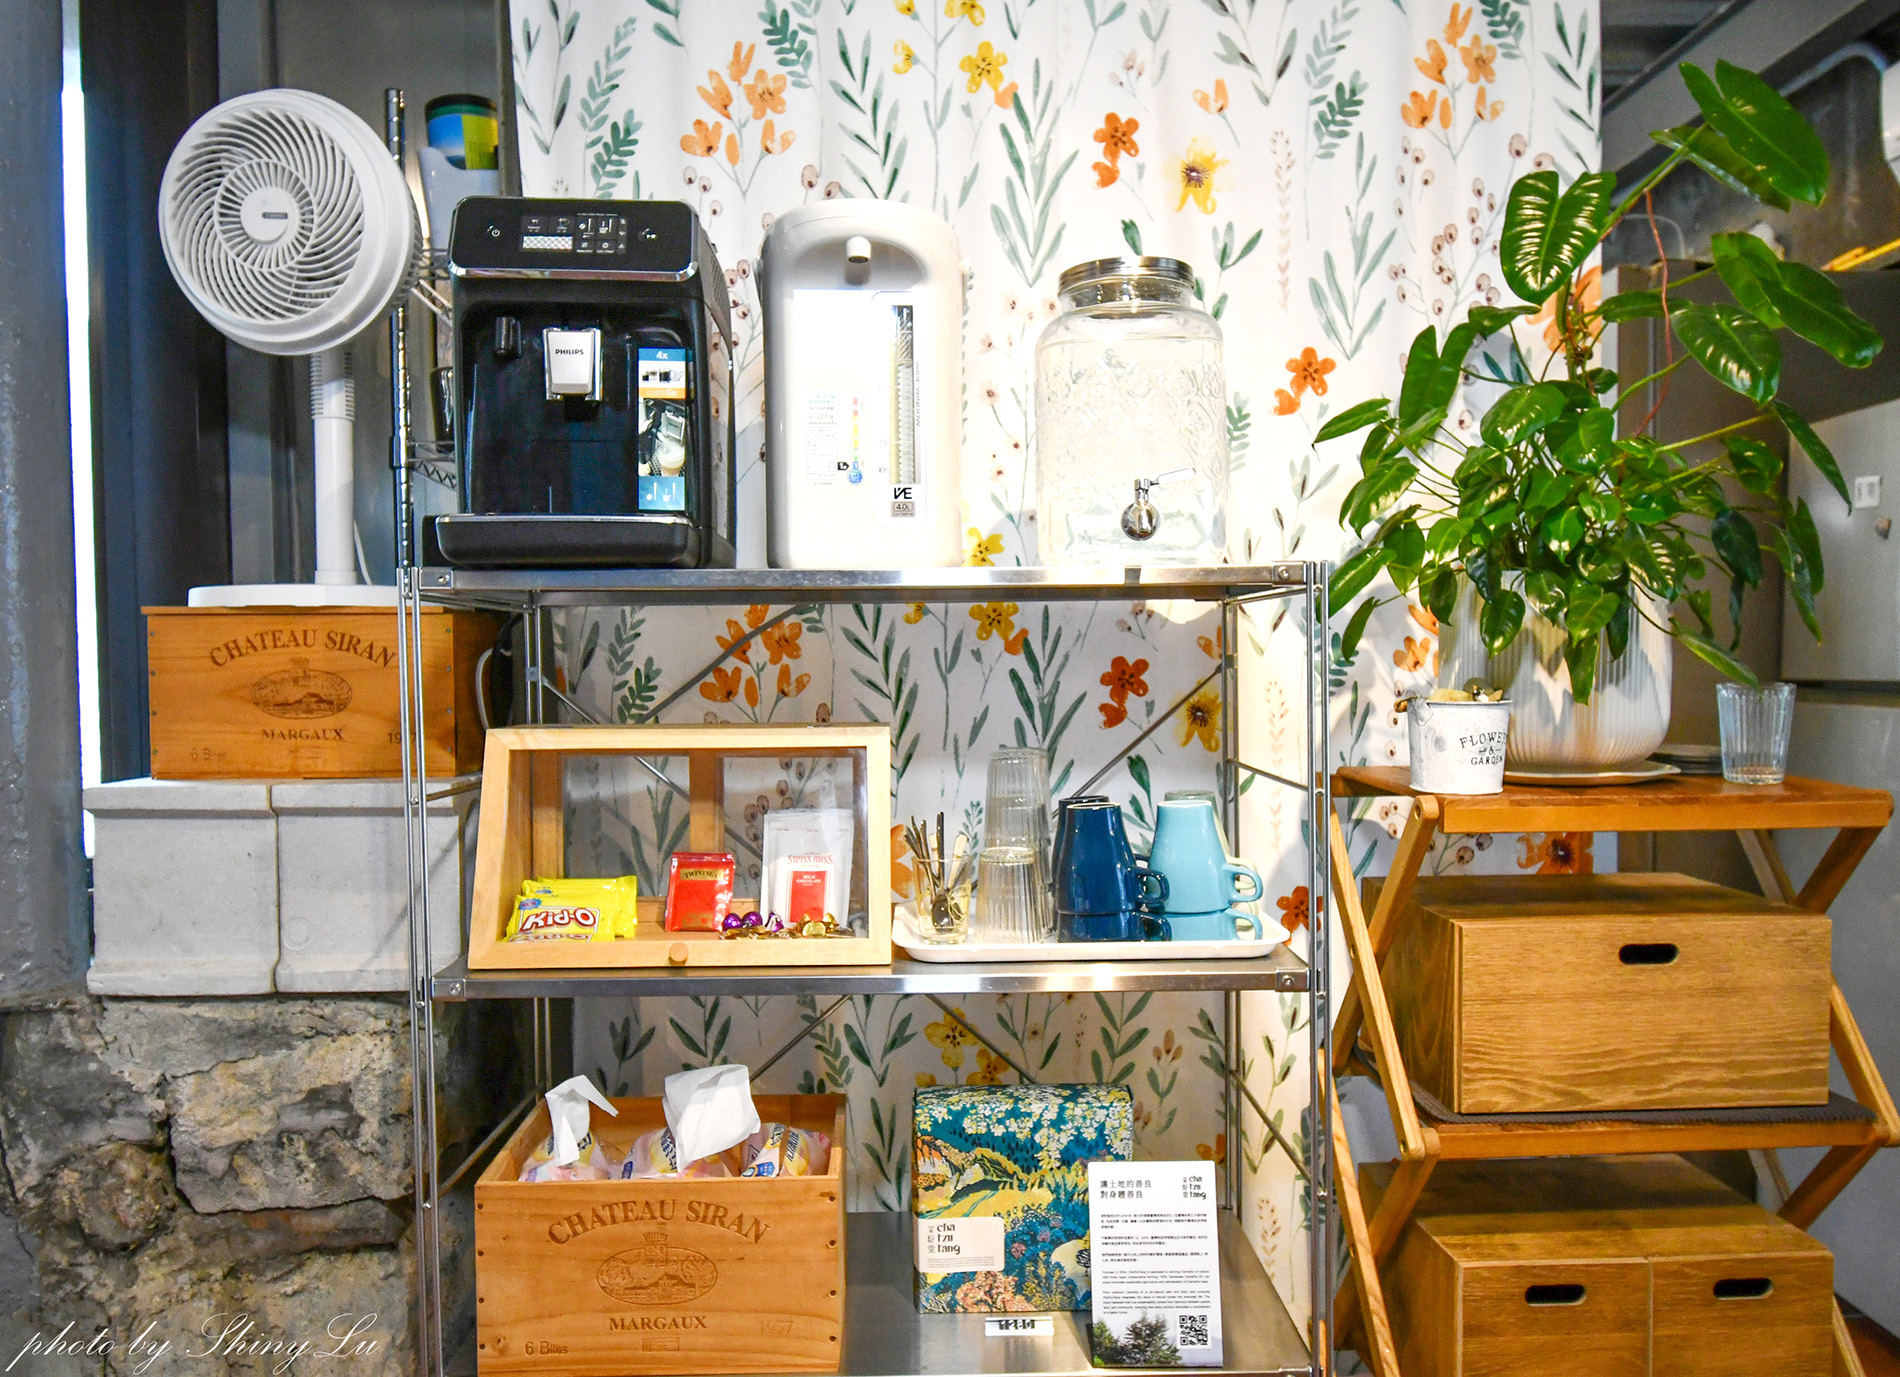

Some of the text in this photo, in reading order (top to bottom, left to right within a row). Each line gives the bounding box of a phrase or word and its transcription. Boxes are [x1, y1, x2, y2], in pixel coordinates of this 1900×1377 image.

[656, 351, 668, 360] 4x
[210, 629, 396, 668] CHATEAU SIRAN
[261, 728, 344, 742] MARGAUX
[388, 731, 417, 744] 197
[684, 870, 718, 879] TWININGS
[548, 1199, 770, 1244] CHATEAU SIRAN
[609, 1316, 707, 1331] MARGAUX
[1000, 1318, 1033, 1330] 1280
[524, 1341, 534, 1355] 6
